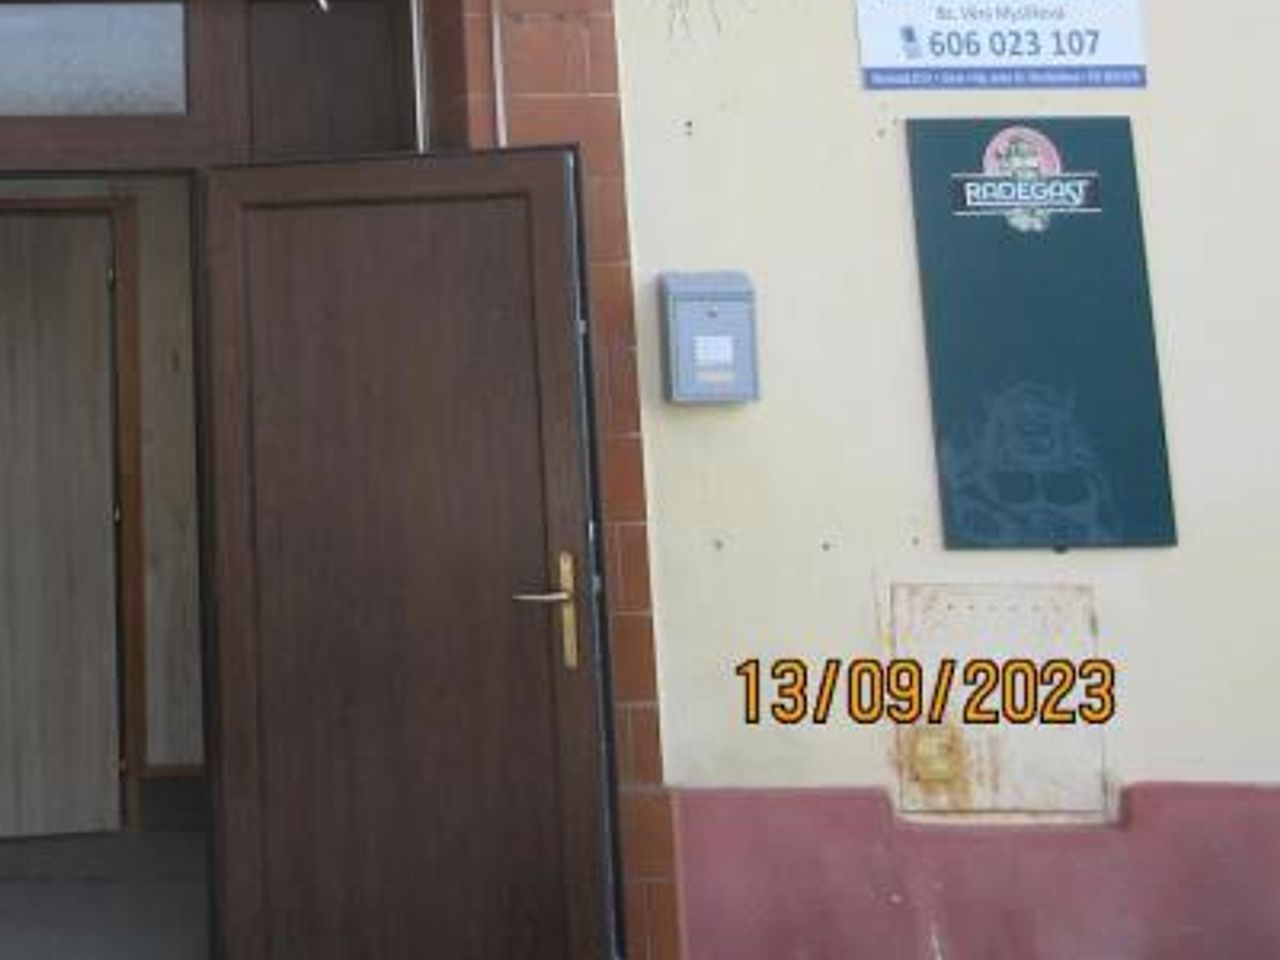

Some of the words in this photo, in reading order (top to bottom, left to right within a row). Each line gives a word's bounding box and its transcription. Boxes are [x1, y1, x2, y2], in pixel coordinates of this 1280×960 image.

[928, 30, 981, 56] 606
[988, 29, 1042, 56] 023
[1051, 28, 1100, 55] 107
[964, 180, 1089, 208] RADEGAST
